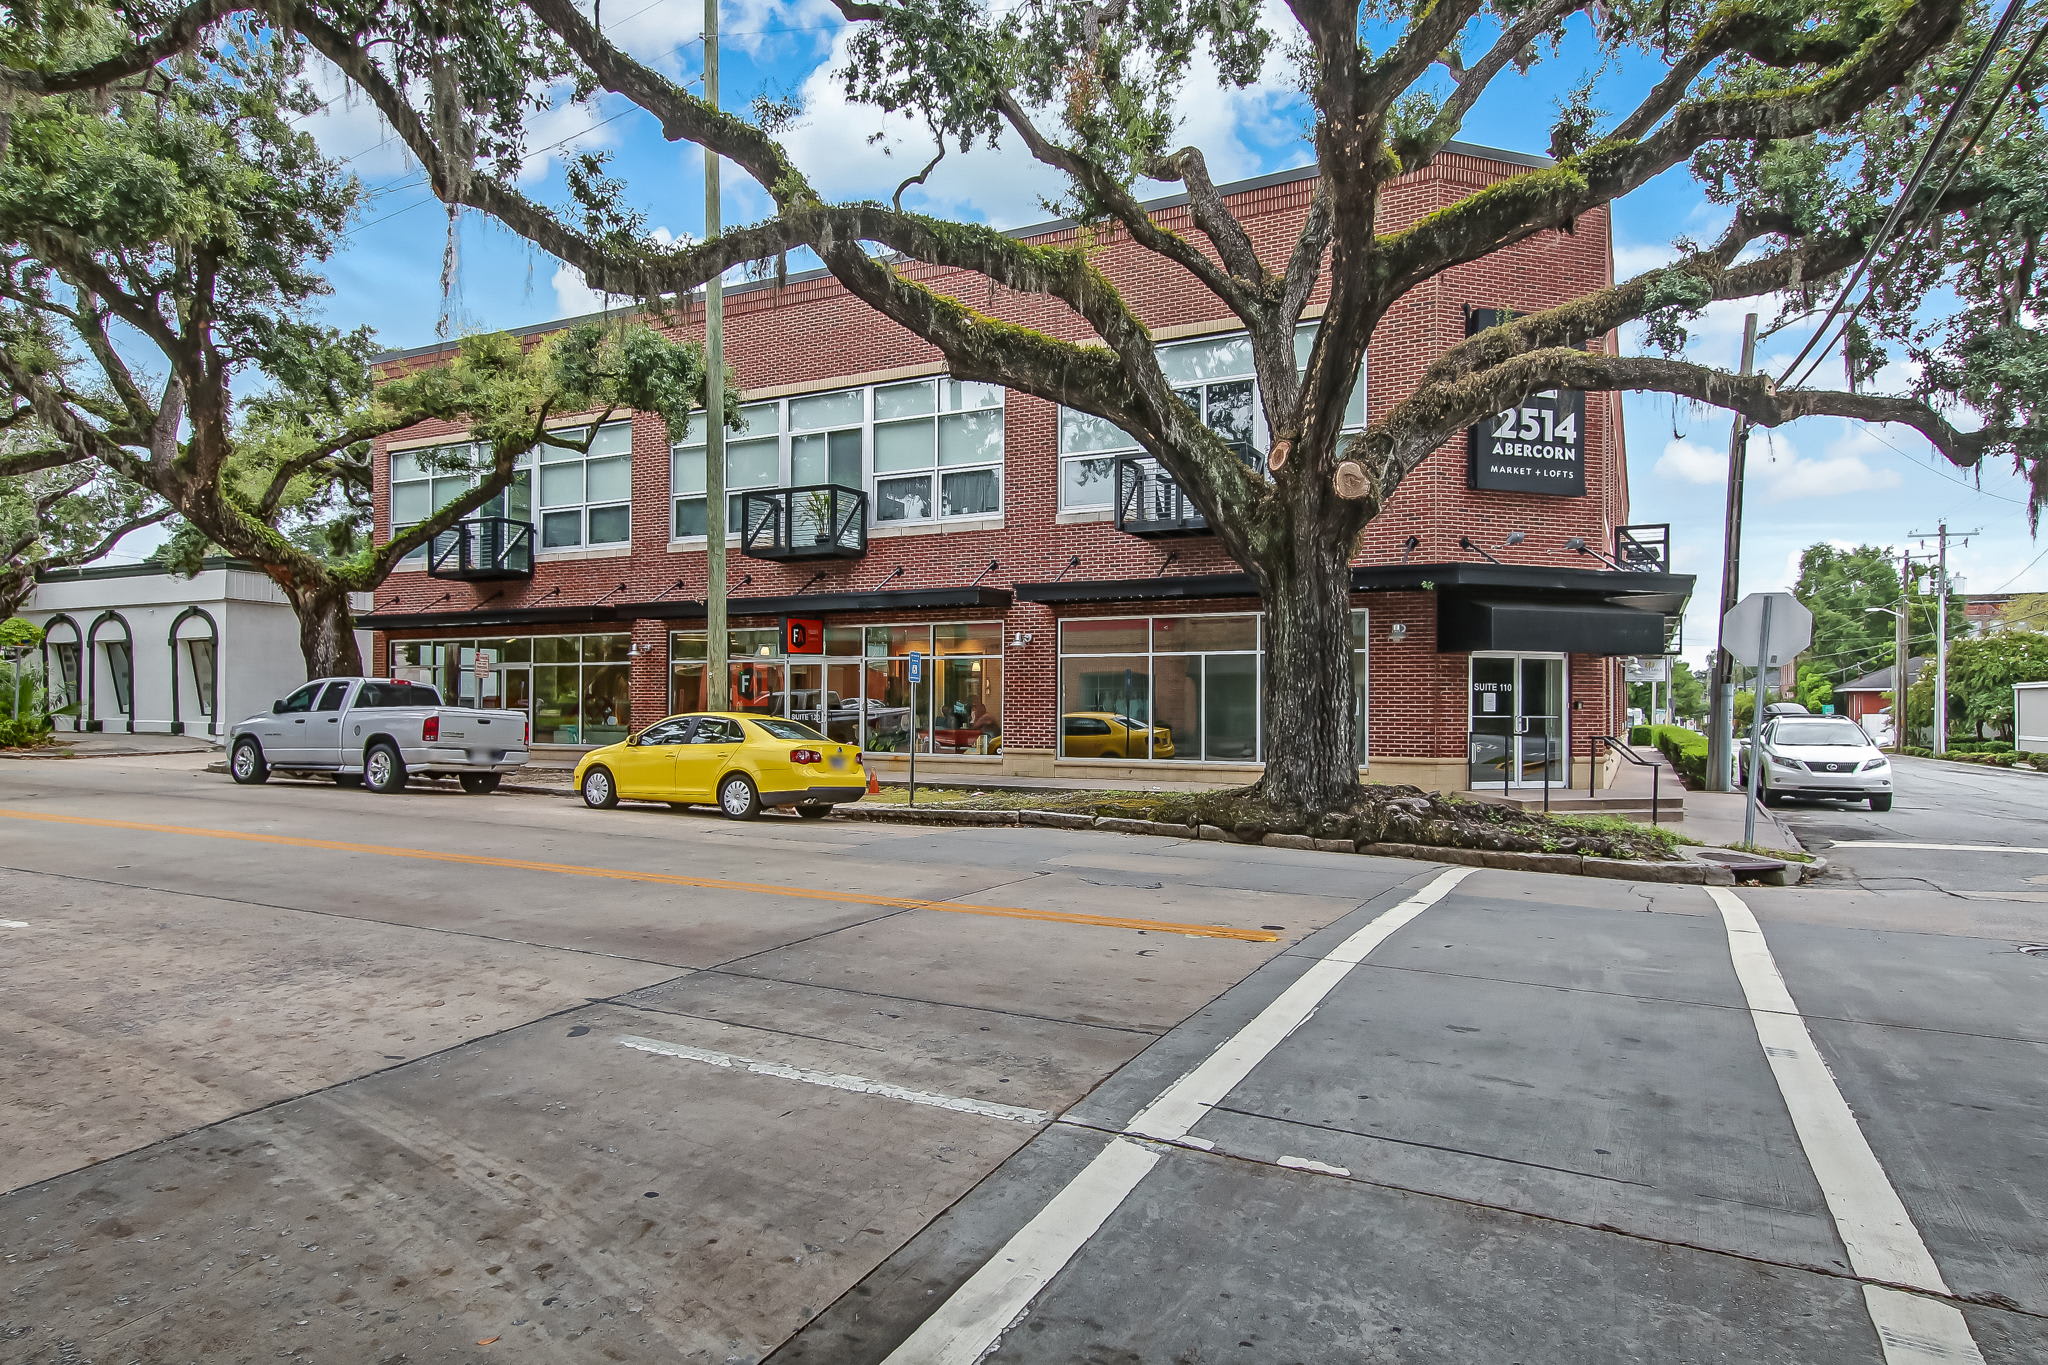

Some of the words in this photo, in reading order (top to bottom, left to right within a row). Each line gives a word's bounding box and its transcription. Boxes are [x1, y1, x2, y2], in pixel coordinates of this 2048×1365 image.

[1491, 407, 1577, 444] 2514
[1492, 441, 1576, 461] ABERCORN
[1490, 465, 1532, 475] MARKET
[1543, 469, 1574, 479] LOFTS
[1473, 682, 1498, 692] SUITE
[1500, 683, 1512, 692] 110
[791, 713, 809, 721] SUITE
